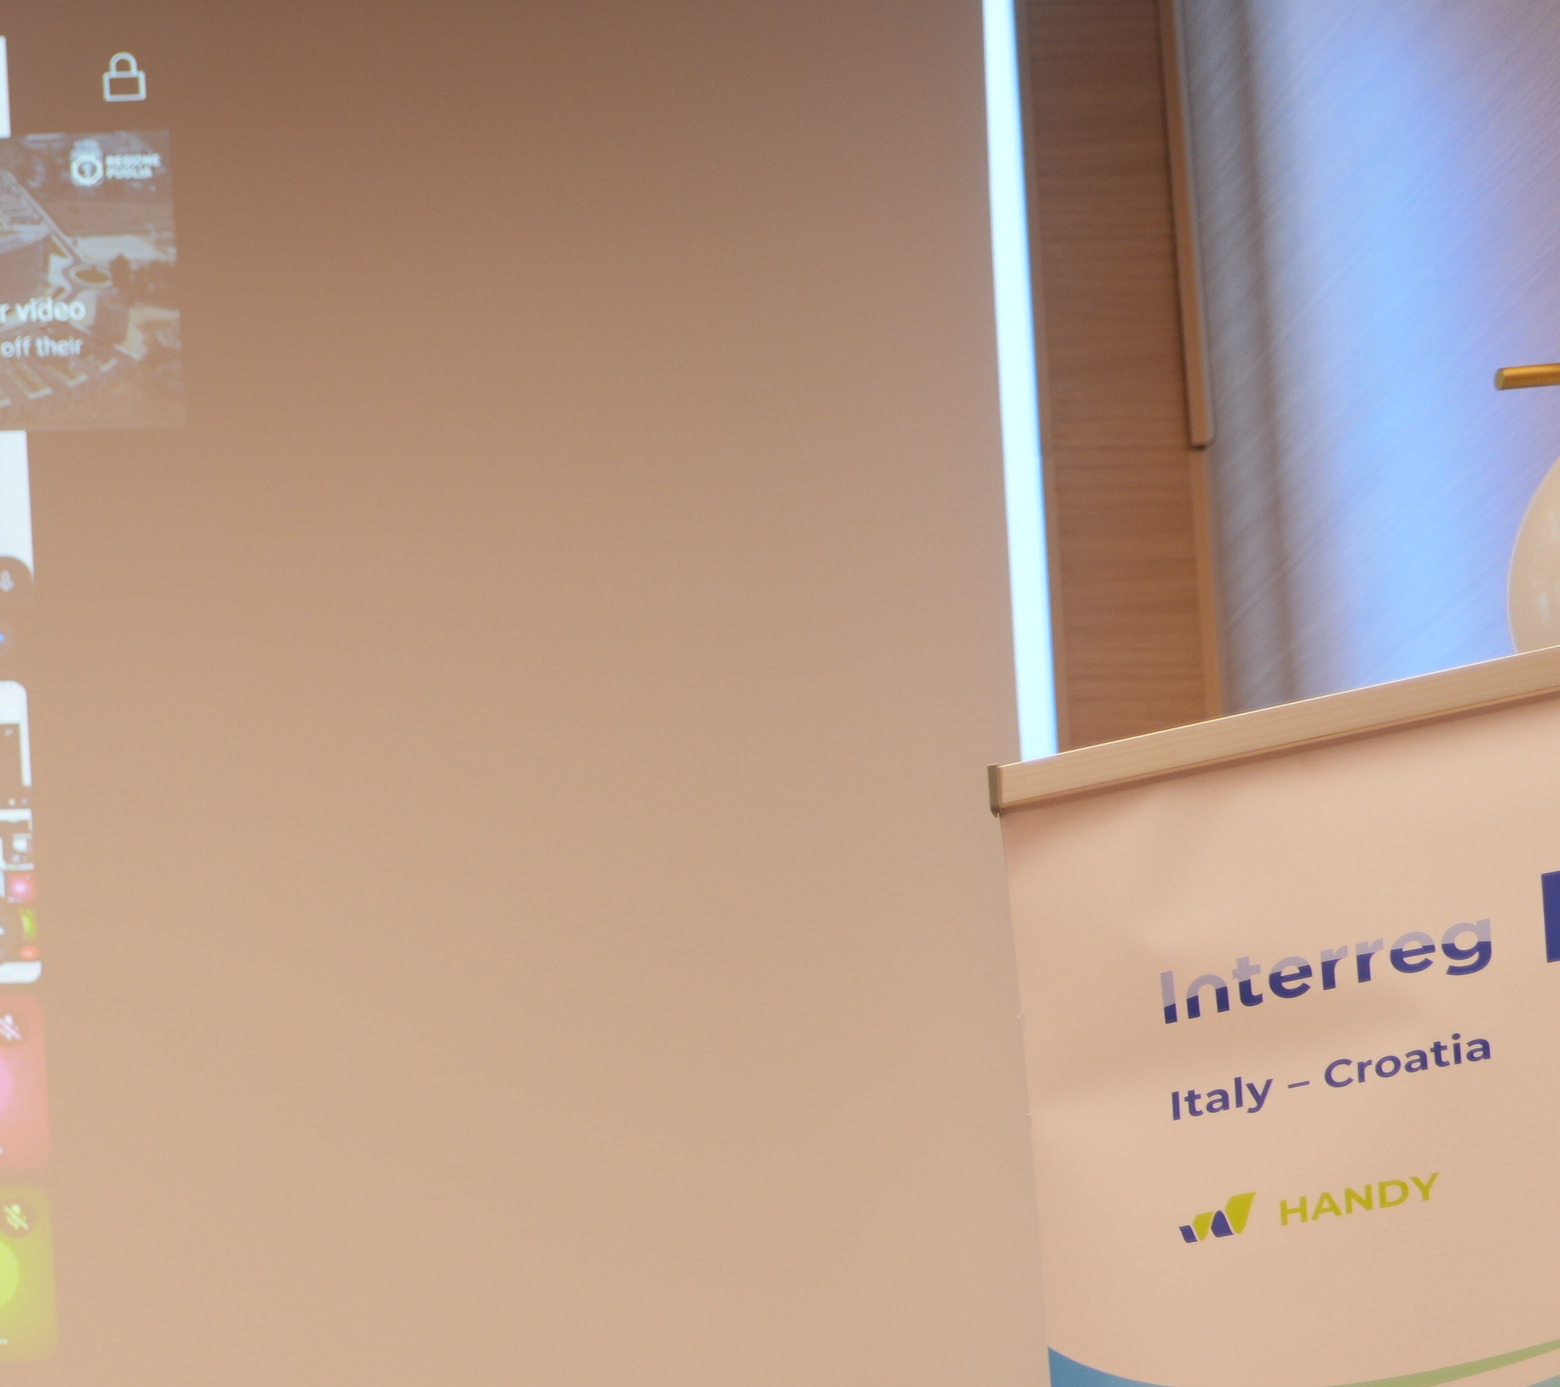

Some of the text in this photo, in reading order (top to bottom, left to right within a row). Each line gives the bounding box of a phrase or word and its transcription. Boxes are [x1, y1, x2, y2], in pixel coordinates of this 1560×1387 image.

[15, 300, 86, 322] video
[1, 338, 31, 358] off
[36, 337, 83, 357] their
[1160, 919, 1493, 1025] Interreg
[1171, 1077, 1273, 1121] Italy
[1324, 1033, 1491, 1088] Croatia
[1279, 1172, 1440, 1226] HANDY
